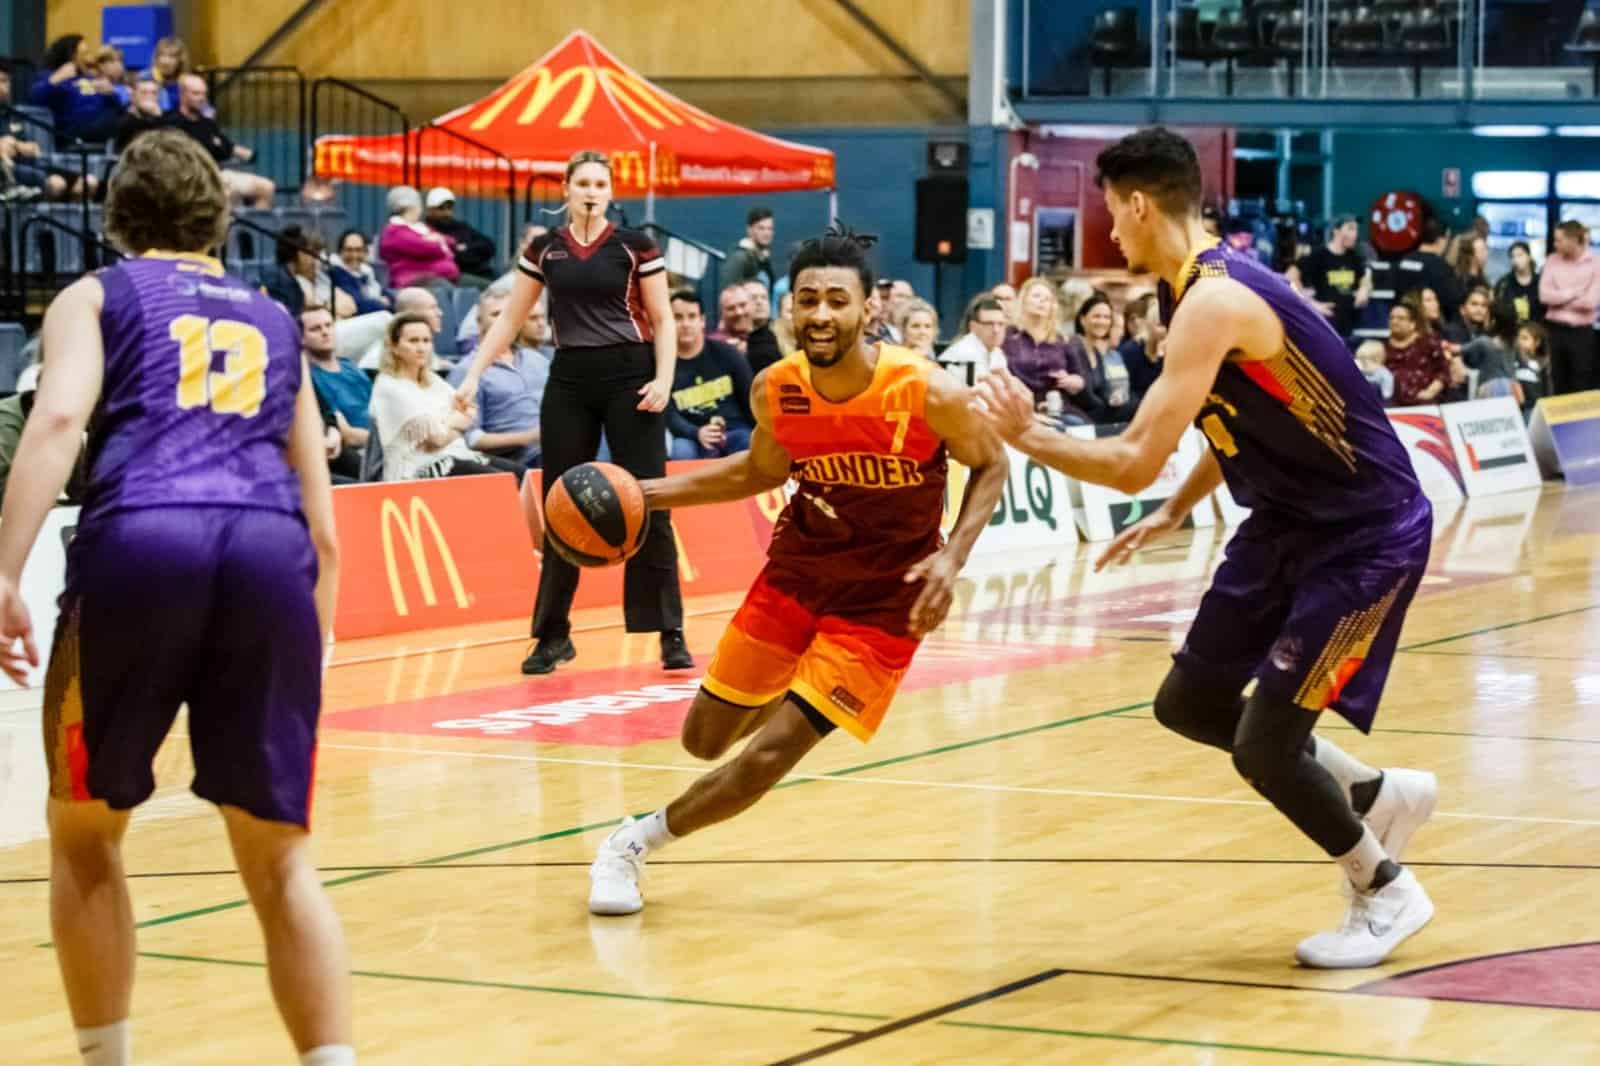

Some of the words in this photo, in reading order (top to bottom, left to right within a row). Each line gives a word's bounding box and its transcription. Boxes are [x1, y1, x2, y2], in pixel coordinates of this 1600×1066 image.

[169, 314, 268, 418] 13
[885, 411, 911, 454] 7
[795, 452, 924, 489] HUNDER
